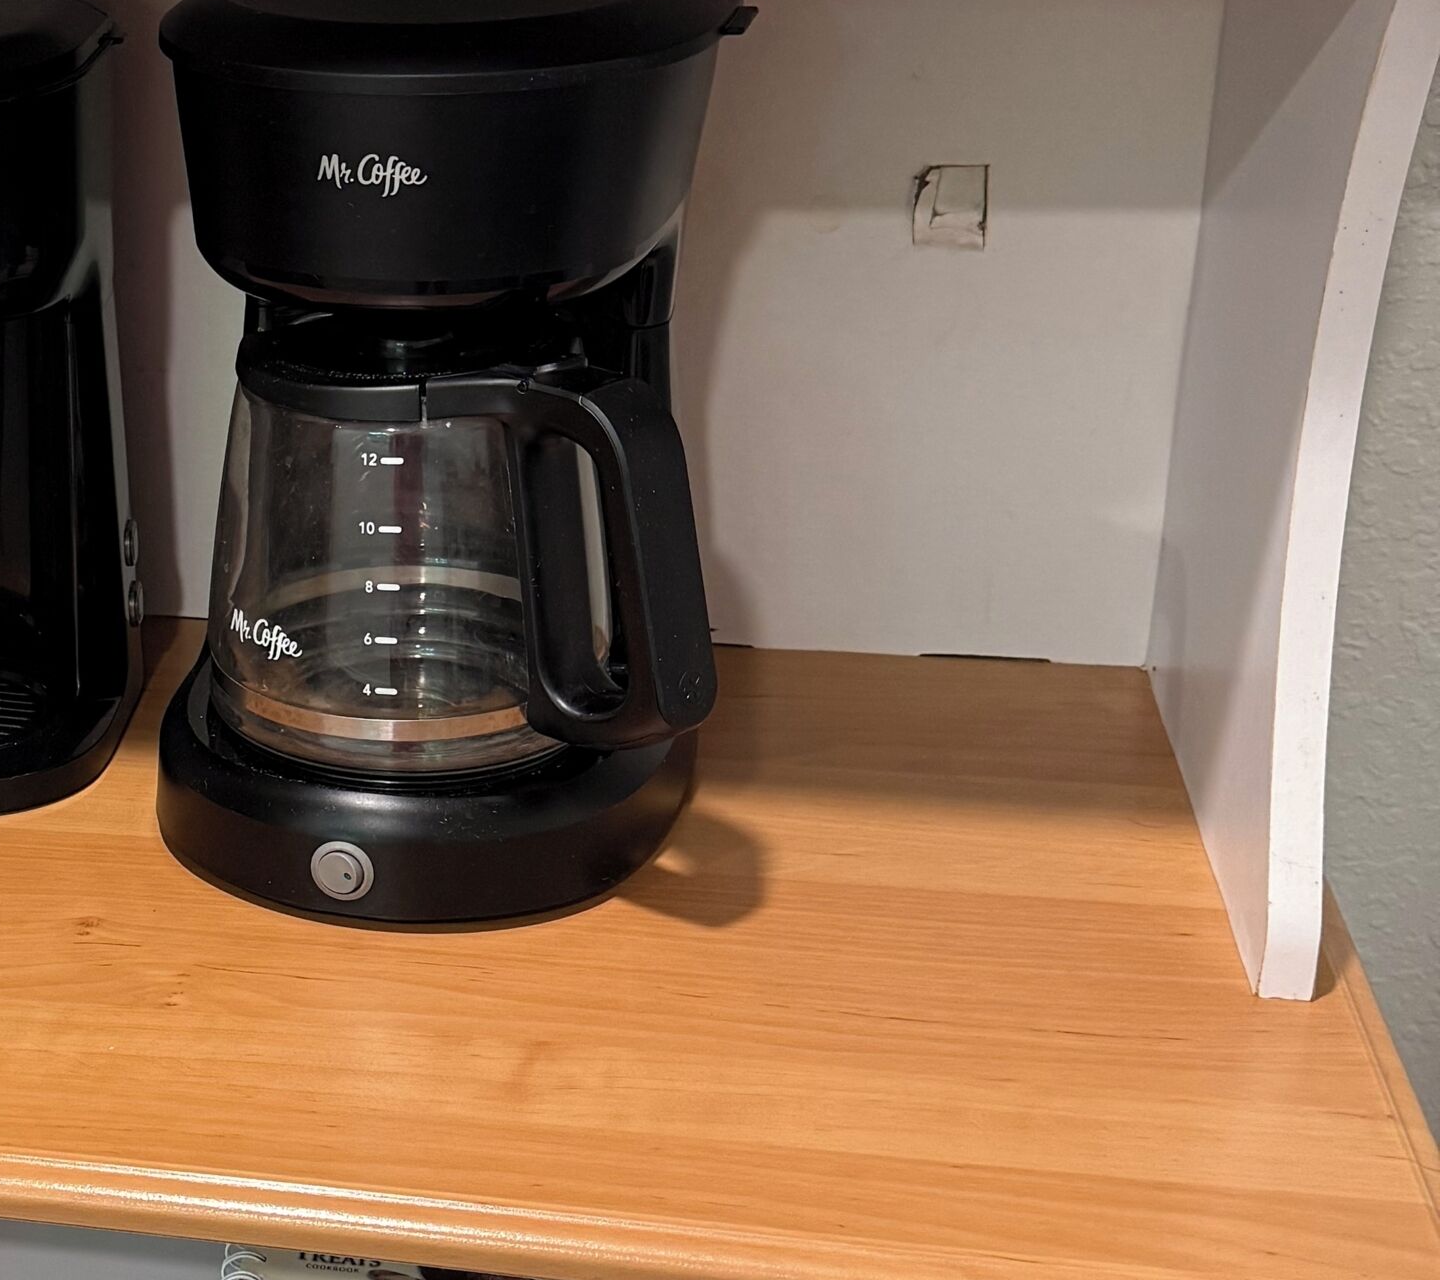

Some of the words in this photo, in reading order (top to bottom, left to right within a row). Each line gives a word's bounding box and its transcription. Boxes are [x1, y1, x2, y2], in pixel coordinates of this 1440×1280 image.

[317, 153, 354, 189] Mr.
[357, 153, 428, 197] Coffee
[361, 453, 377, 466] 12
[359, 521, 375, 535] 10
[365, 580, 373, 593] 8
[230, 608, 252, 643] Mr.
[253, 618, 303, 660] Coffee
[364, 632, 372, 645] 6
[362, 683, 371, 696] 4
[305, 1263, 360, 1273] COOKBOOK
